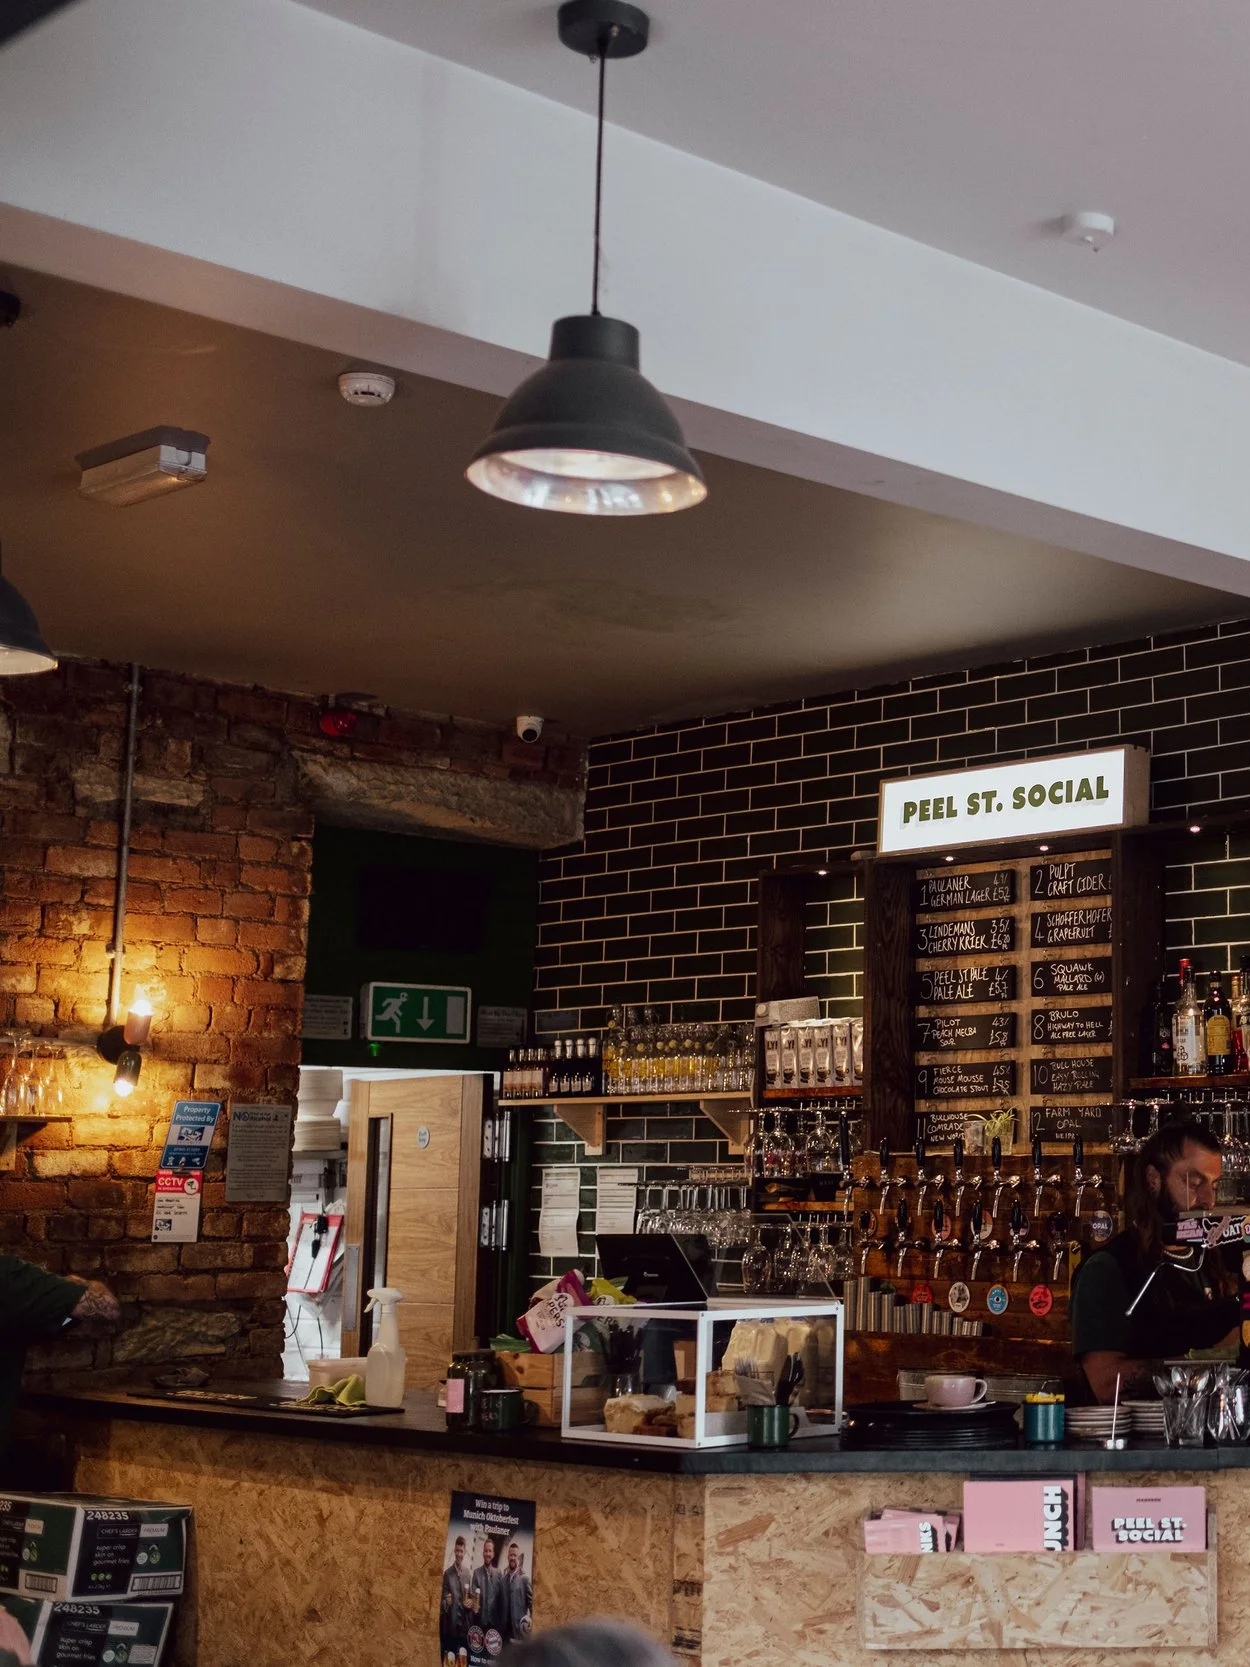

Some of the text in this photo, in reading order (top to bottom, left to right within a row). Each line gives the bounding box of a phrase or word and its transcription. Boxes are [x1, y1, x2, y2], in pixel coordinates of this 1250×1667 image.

[903, 776, 1109, 824] PEEL ST. SOCIAL
[1050, 863, 1076, 880] PULPT
[929, 875, 971, 893] PAULANER
[1034, 869, 1044, 894] 2
[1047, 879, 1074, 896] CRAFT
[1076, 873, 1107, 893] CIDER
[919, 885, 928, 906] 1
[931, 891, 963, 907] GERMAN
[965, 887, 991, 903] LAGER
[929, 921, 975, 938] LINDEMANS
[1035, 916, 1045, 942] 4
[1047, 925, 1095, 943] GRAPEFRUIT
[917, 929, 928, 950] 3
[928, 936, 957, 954] CHERRY
[959, 934, 989, 951] KRIEK
[1050, 963, 1094, 975] SQUAWK
[934, 970, 956, 986] PEEL
[958, 969, 968, 983] ST
[970, 967, 989, 982] PALE
[1033, 968, 1044, 989] 6
[1054, 973, 1092, 984] MALLARD
[920, 973, 933, 999] 5
[934, 985, 954, 1000] PALE
[955, 983, 974, 999] ALE
[1056, 984, 1073, 992] PALE
[1048, 1010, 1079, 1021] BRULO
[934, 1018, 960, 1029] PILOT
[1034, 1014, 1045, 1040] 8
[1047, 1021, 1074, 1031] HIGHWAY
[1086, 1020, 1103, 1029] HELL
[917, 1023, 930, 1043] 7
[931, 1029, 953, 1040] PEACH
[955, 1026, 977, 1037] MELBA
[1062, 1030, 1076, 1038] FREE
[1078, 1030, 1096, 1038] LAGER
[933, 1065, 962, 1076] FIERCE
[1049, 1059, 1094, 1070] BULL HOUSE
[918, 1070, 927, 1094] 9
[933, 1074, 984, 1084] MOUSE MOUSSE
[1034, 1064, 1048, 1087] 10
[1051, 1071, 1069, 1081] EASY
[933, 1085, 967, 1095] CHOCOLATE
[1052, 1081, 1094, 1092] HAZY PALE
[183, 1106, 211, 1114] Property
[1045, 1107, 1101, 1118] FARM YARD
[176, 1114, 214, 1124] Protected By
[1031, 1112, 1045, 1133] 12
[1057, 1119, 1081, 1129] OPAL
[930, 1134, 945, 1142] NEW
[157, 1177, 184, 1186] CCTV
[1092, 1222, 1109, 1230] OPAL
[475, 1499, 488, 1508] Win
[492, 1501, 503, 1513] trip
[504, 1504, 510, 1512] to
[86, 1511, 129, 1520] 248235
[463, 1509, 519, 1525] Munich Oktoberfest
[470, 1522, 510, 1536] with Paulaner
[1113, 1517, 1187, 1530] PEEL ST.
[1118, 1529, 1184, 1542] SOCIAL
[53, 1603, 100, 1615] 248235
